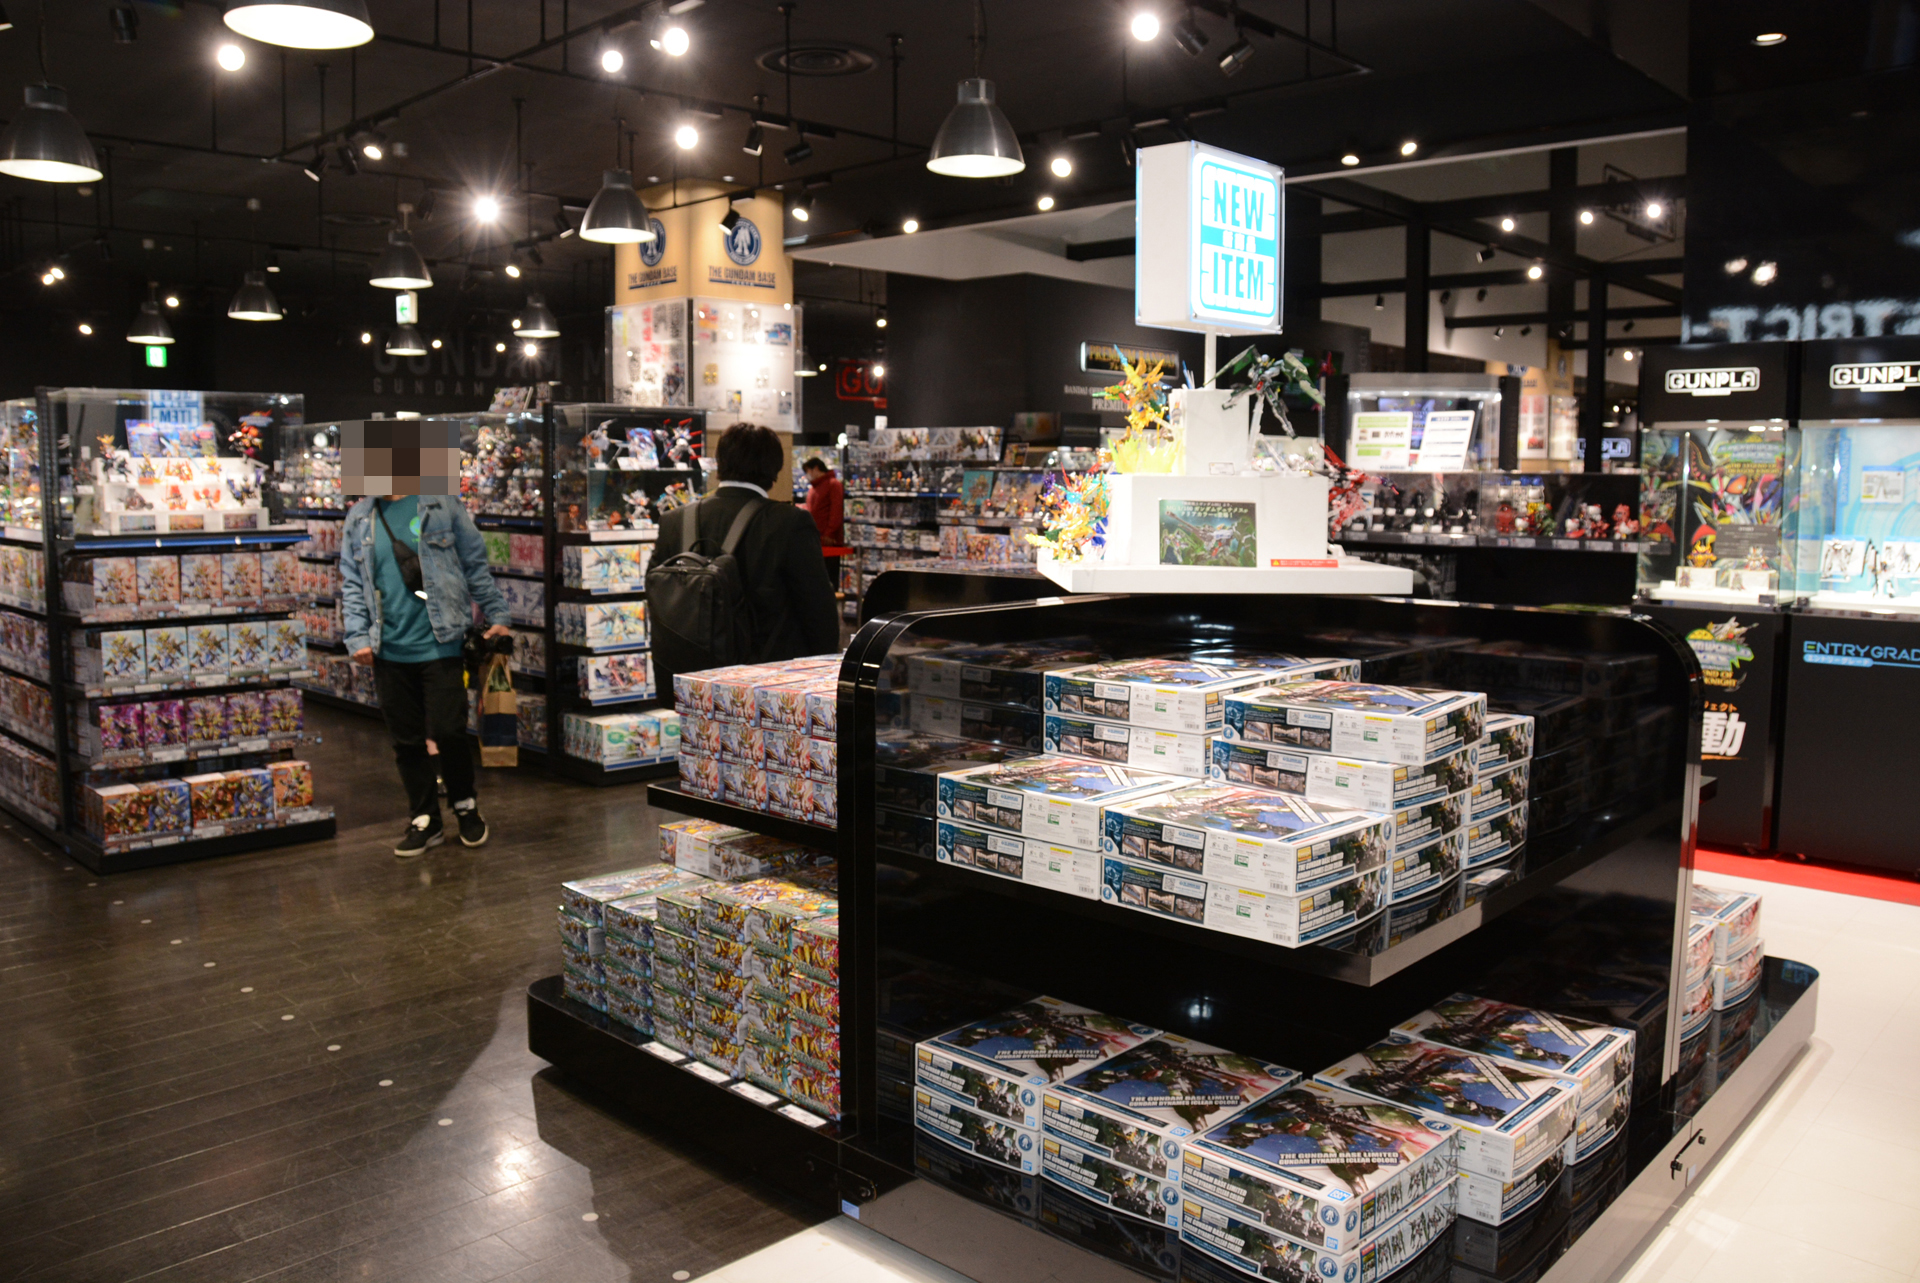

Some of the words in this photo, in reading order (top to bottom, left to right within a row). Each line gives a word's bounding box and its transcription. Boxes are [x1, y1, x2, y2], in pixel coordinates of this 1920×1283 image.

[1214, 180, 1264, 232] NEW
[628, 273, 637, 284] THE
[638, 268, 662, 282] GUNDAM
[663, 265, 677, 278] BASE
[708, 266, 722, 278] THE
[724, 267, 755, 281] GUNDAM
[757, 271, 776, 284] BASE
[1213, 251, 1264, 301] ITEM
[1669, 371, 1756, 389] GUNPLA
[1803, 640, 1870, 657] ENTRY
[1720, 671, 1734, 679] OF
[1184, 1166, 1193, 1174] THE
[1193, 1169, 1214, 1183] GUNDAM
[1214, 1178, 1227, 1189] BASE
[1226, 1183, 1247, 1196] LIMITED
[1184, 1214, 1192, 1223] THE
[1192, 1219, 1213, 1233] GUNDAM
[1212, 1228, 1225, 1238] BASE
[1225, 1233, 1245, 1247] LIMITED
